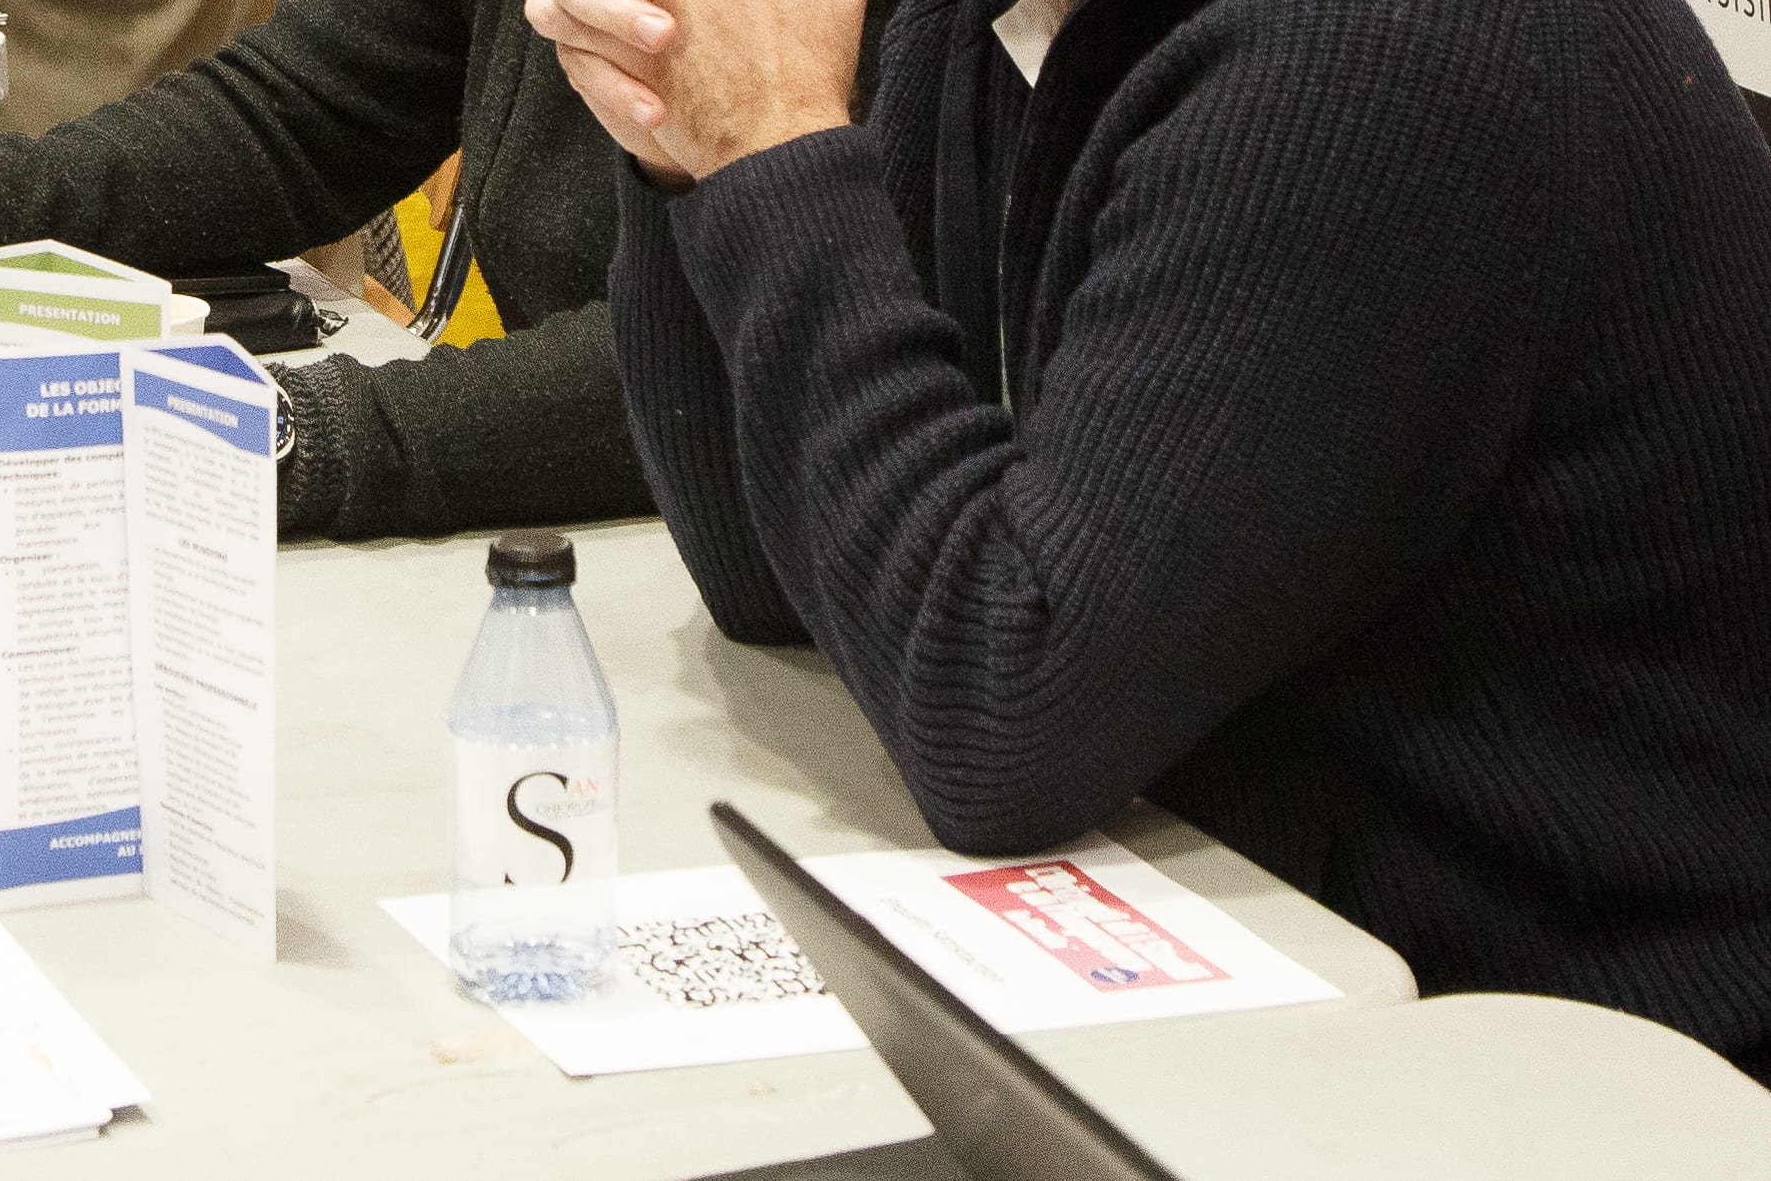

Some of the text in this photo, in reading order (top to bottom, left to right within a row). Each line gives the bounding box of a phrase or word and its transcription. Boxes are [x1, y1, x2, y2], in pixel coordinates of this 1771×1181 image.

[19, 304, 121, 326] PRESENTATION
[40, 380, 71, 398] LES
[25, 402, 50, 420] DE
[52, 400, 74, 418] LA
[64, 455, 83, 464] des
[118, 846, 136, 858] AU
